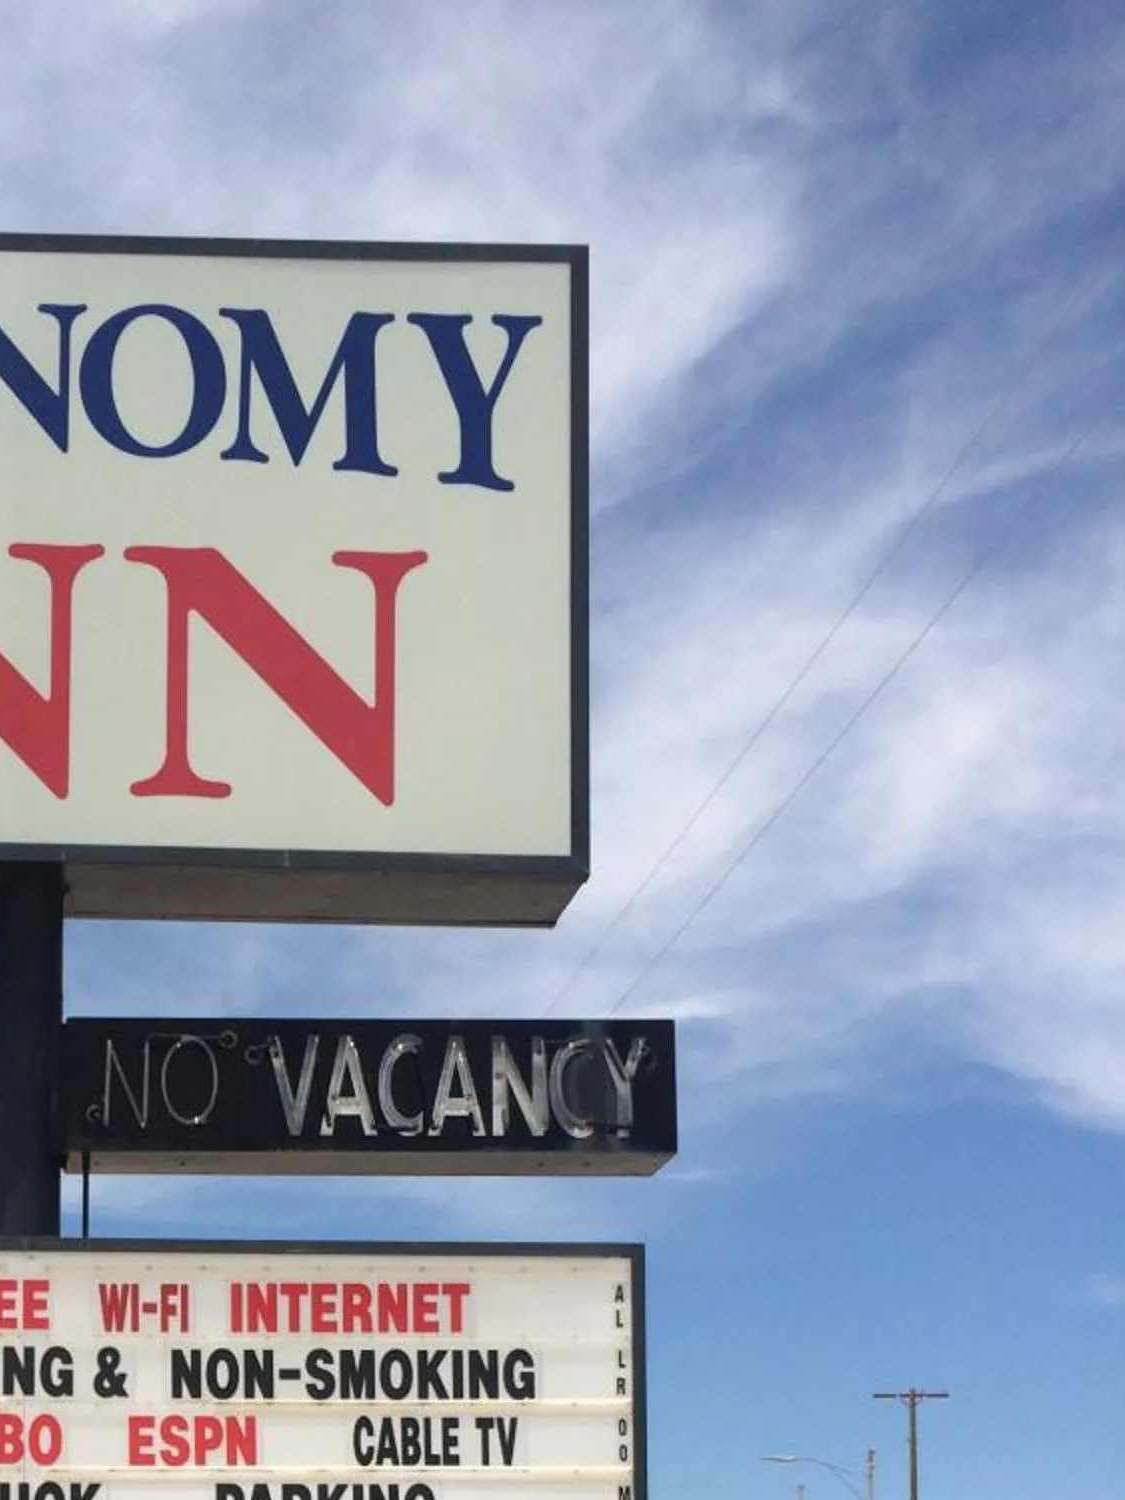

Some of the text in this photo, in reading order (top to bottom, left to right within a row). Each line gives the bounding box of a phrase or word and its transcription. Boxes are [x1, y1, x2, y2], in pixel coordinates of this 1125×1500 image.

[103, 1034, 649, 1138] NO VACANCY
[98, 1282, 190, 1334] WI-FI
[230, 1282, 471, 1334] INTERNET
[93, 1346, 129, 1399] &
[170, 1347, 536, 1401] NON-SMOKING
[128, 1415, 257, 1467] ESPN
[352, 1415, 460, 1467] CABLE
[474, 1416, 518, 1467] TV
